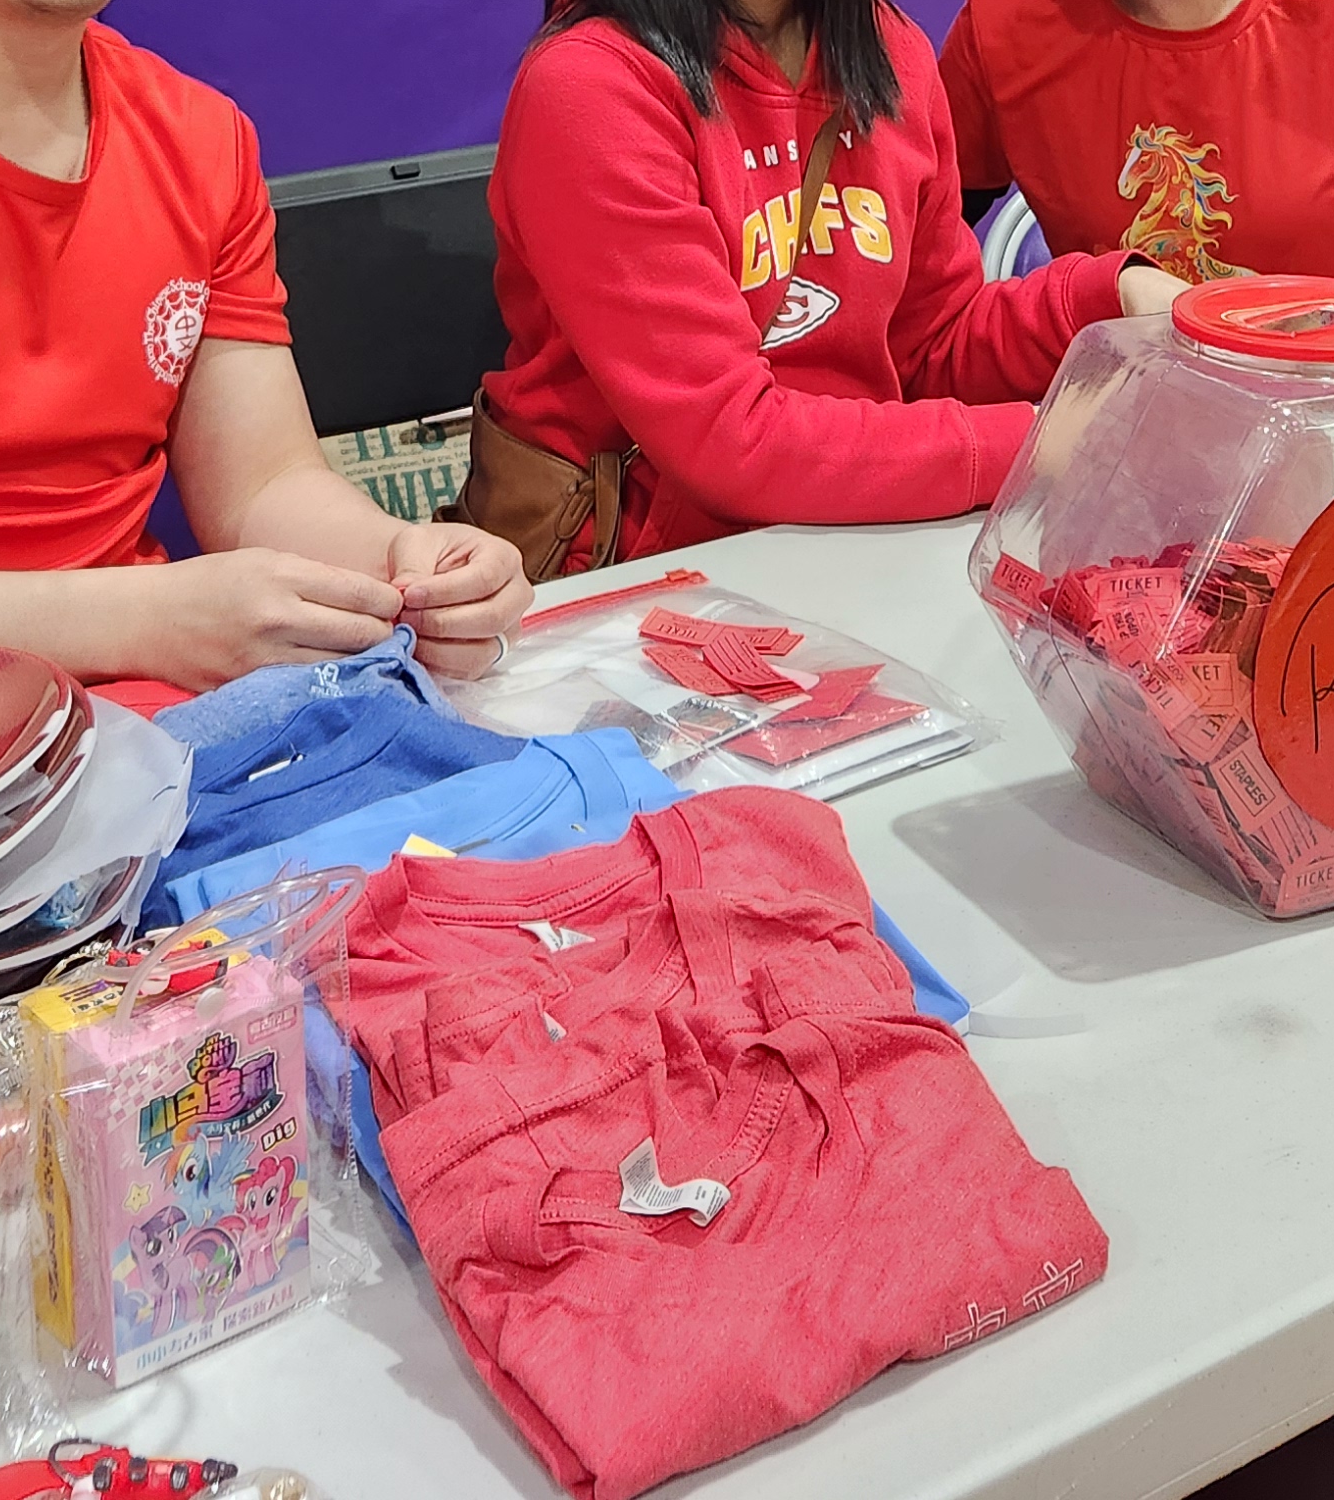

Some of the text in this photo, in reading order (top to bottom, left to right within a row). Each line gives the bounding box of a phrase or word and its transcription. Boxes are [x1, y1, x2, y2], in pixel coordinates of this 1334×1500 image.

[167, 277, 207, 295] School
[1002, 563, 1034, 591] TICKET
[1110, 576, 1163, 593] TICKET
[1229, 759, 1268, 806] STAPLES
[261, 1117, 297, 1151] Dig
